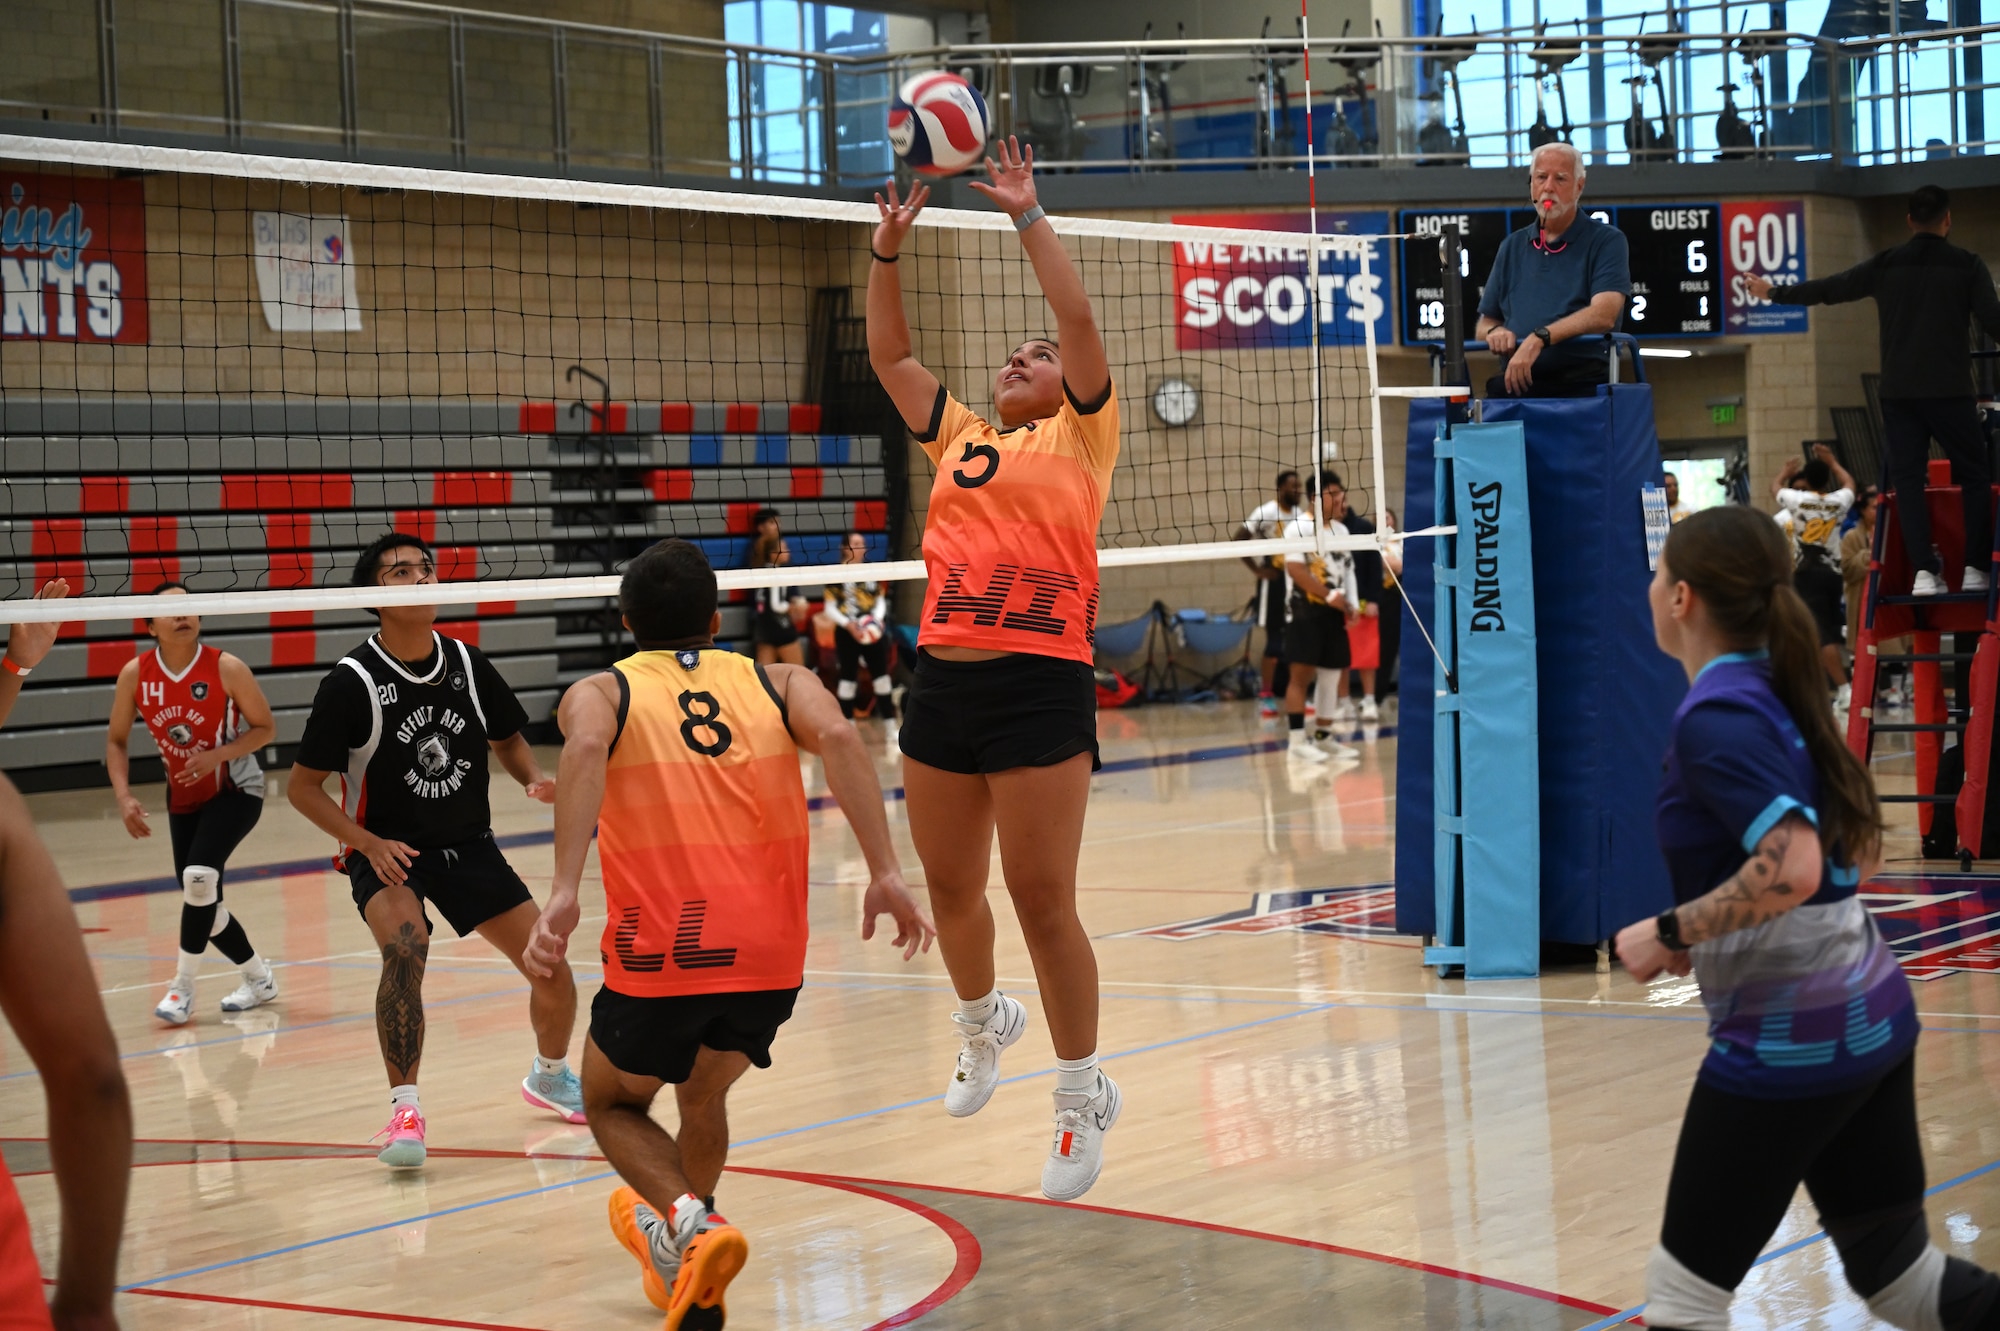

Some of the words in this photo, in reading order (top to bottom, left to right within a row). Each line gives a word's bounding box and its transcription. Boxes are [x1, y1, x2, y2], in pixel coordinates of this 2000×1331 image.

[1650, 209, 1711, 230] GUEST
[1729, 213, 1799, 272] GO!
[1687, 239, 1708, 273] 6
[1680, 280, 1711, 293] FOULS
[1183, 273, 1385, 328] SCOTS
[1630, 295, 1648, 321] 2
[1419, 301, 1445, 327] 10
[1681, 319, 1712, 332] SCORE
[1712, 406, 1735, 424] EXIT
[1468, 481, 1506, 633] SPALDING
[141, 681, 165, 706] 14
[378, 682, 399, 706] 20
[152, 705, 183, 728] OFFUTT
[186, 708, 206, 726] AFB
[439, 708, 466, 735] AFB
[678, 689, 733, 758] 8
[403, 758, 472, 799] WARHAWKS
